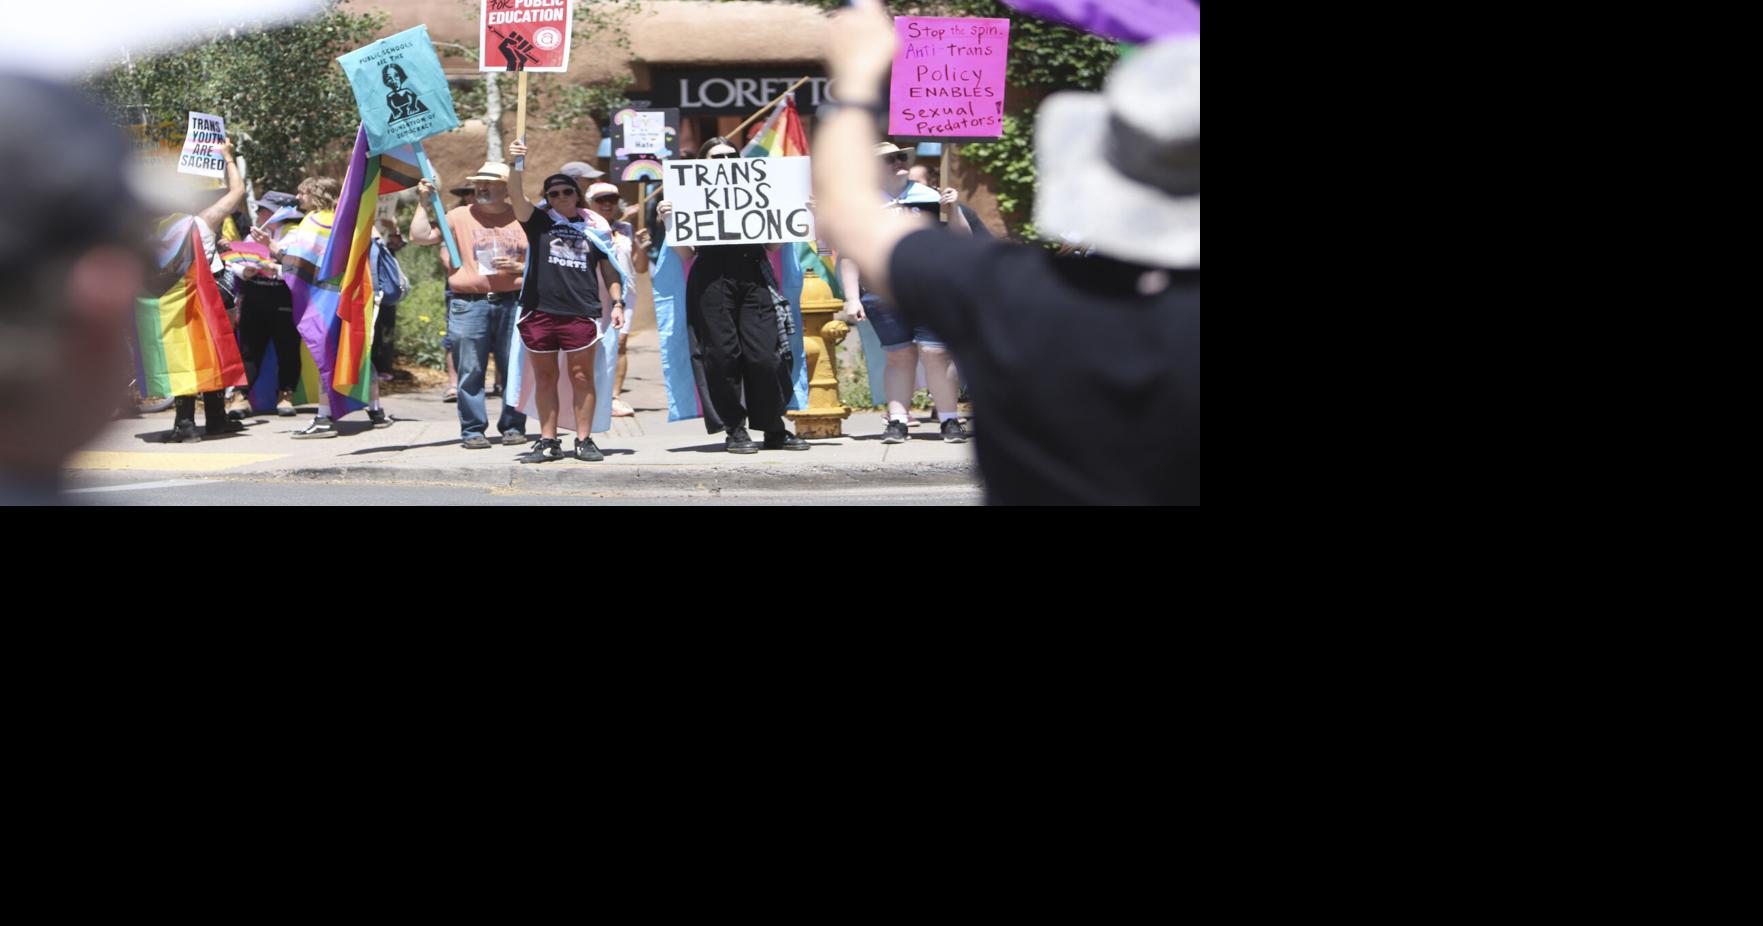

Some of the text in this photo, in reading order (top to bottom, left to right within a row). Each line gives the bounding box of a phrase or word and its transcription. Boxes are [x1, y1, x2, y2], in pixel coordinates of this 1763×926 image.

[488, 8, 564, 25] EDUCATION
[908, 22, 1003, 44] Stop the spin.
[359, 42, 414, 64] PUBLIC SCHOOLS
[389, 53, 404, 61] THE
[917, 64, 982, 88] Policy
[909, 86, 994, 98] ENABLES
[192, 117, 221, 133] TRANS
[192, 131, 226, 145] YOUTH
[192, 144, 214, 157] ARE
[181, 154, 225, 171] SACRED
[670, 159, 767, 186] TRANS
[704, 182, 772, 210] KIDS
[675, 208, 810, 242] BELONG
